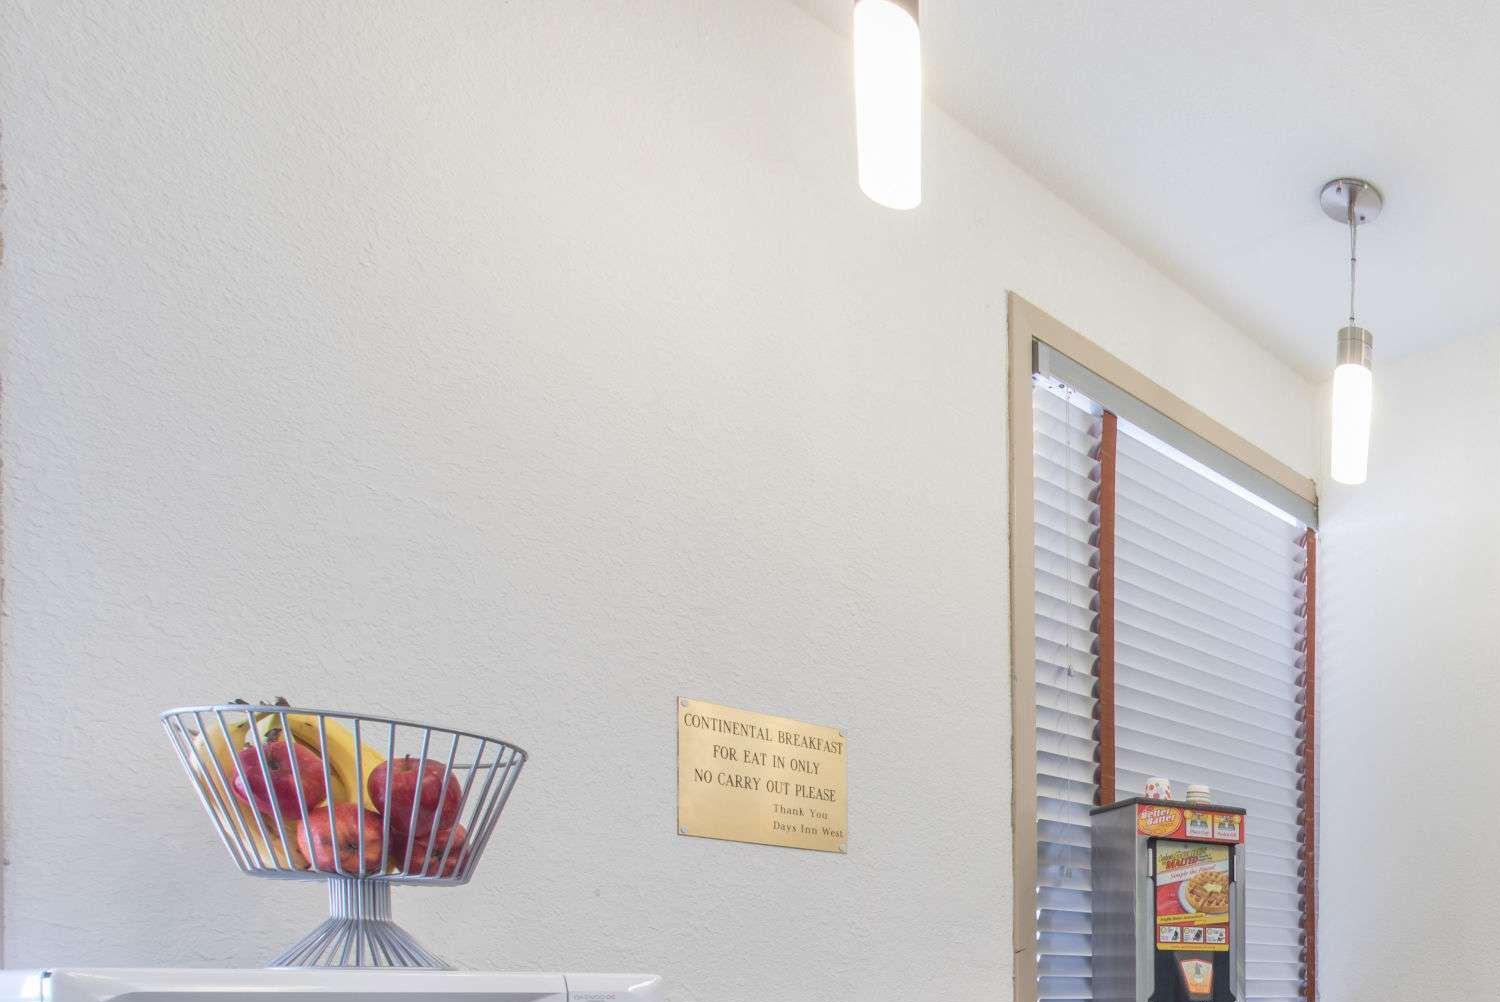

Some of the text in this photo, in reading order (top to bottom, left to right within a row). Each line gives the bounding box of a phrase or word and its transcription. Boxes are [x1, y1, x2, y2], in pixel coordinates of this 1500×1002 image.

[683, 713, 844, 755] CONTINENTAL BREAKFAST
[712, 744, 820, 775] FOR EAT IN ONLY
[694, 768, 836, 802] NO CARRY OUT PLEASE
[773, 804, 828, 820] Thank You
[773, 821, 844, 838] Days Inn West
